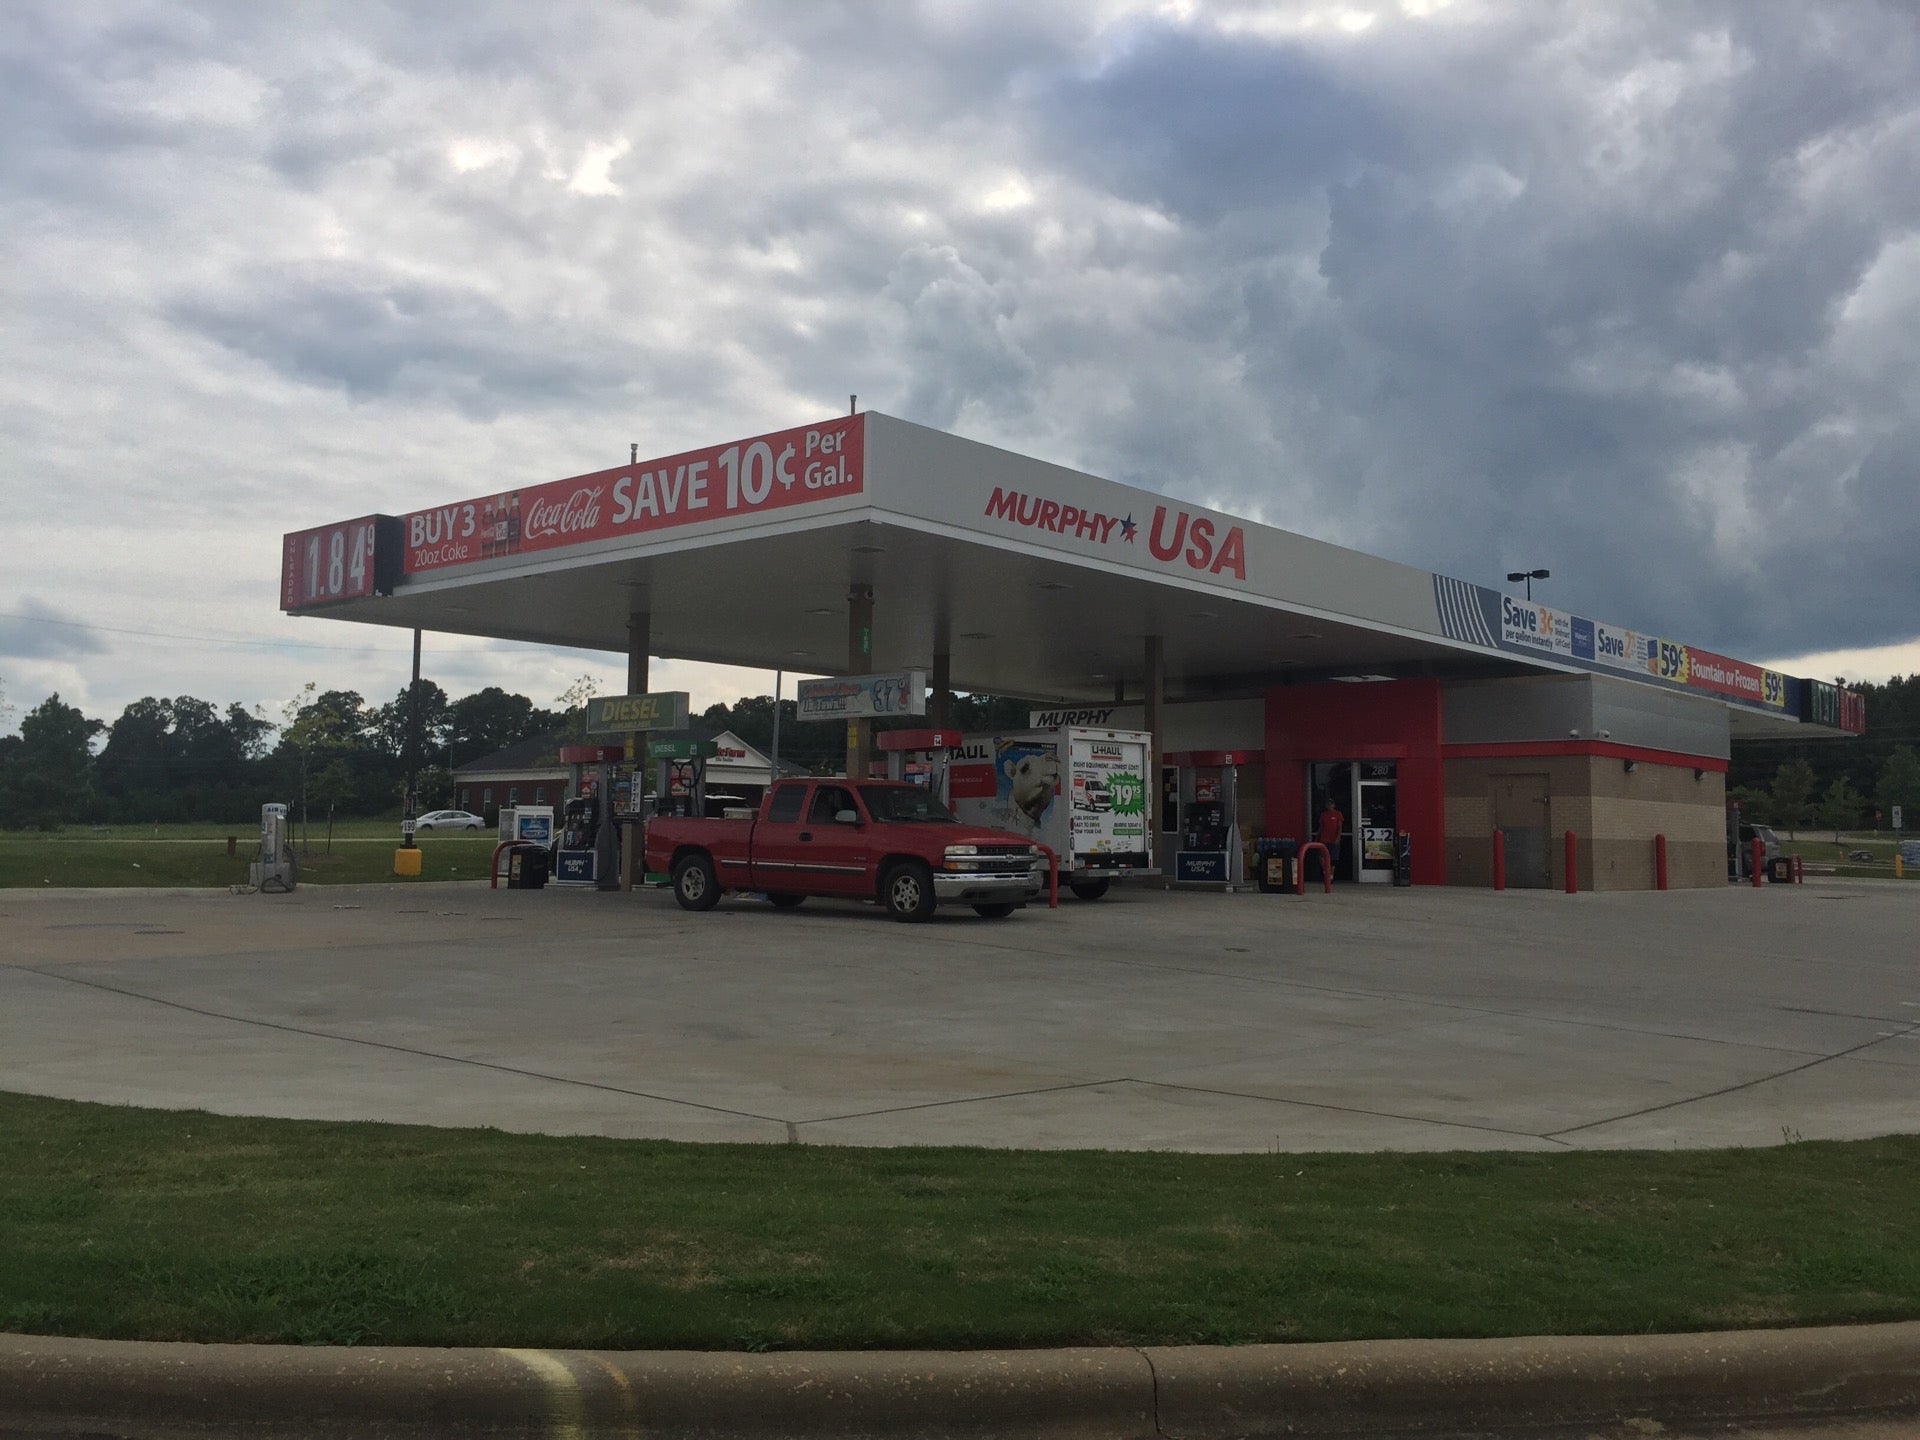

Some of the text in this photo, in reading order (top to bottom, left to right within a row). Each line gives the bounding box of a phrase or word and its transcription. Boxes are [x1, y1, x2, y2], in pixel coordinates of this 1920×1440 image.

[804, 428, 846, 458] Per
[804, 461, 853, 490] Gal.
[524, 441, 796, 540] Coca-Cola SAVE 10¢
[410, 506, 459, 548] BUY
[461, 504, 476, 537] 3
[984, 486, 1246, 580] MURPHY USA
[415, 544, 468, 567] 20oz Coke
[287, 538, 297, 604] UNLEADED
[1503, 597, 1554, 636] Save 3¢
[1505, 629, 1554, 650] per gallon instantly
[1598, 628, 1624, 658] Save
[1661, 642, 1683, 678] 59¢
[1691, 657, 1759, 692] Fountain or Frozen
[1765, 673, 1782, 701] 59¢
[601, 698, 660, 722] DIESEL
[1036, 709, 1114, 726] MURPHY
[654, 744, 677, 753] DIESEL
[1092, 745, 1122, 756] U-HAUL
[1371, 765, 1389, 776] 280
[1366, 829, 1375, 842] 2
